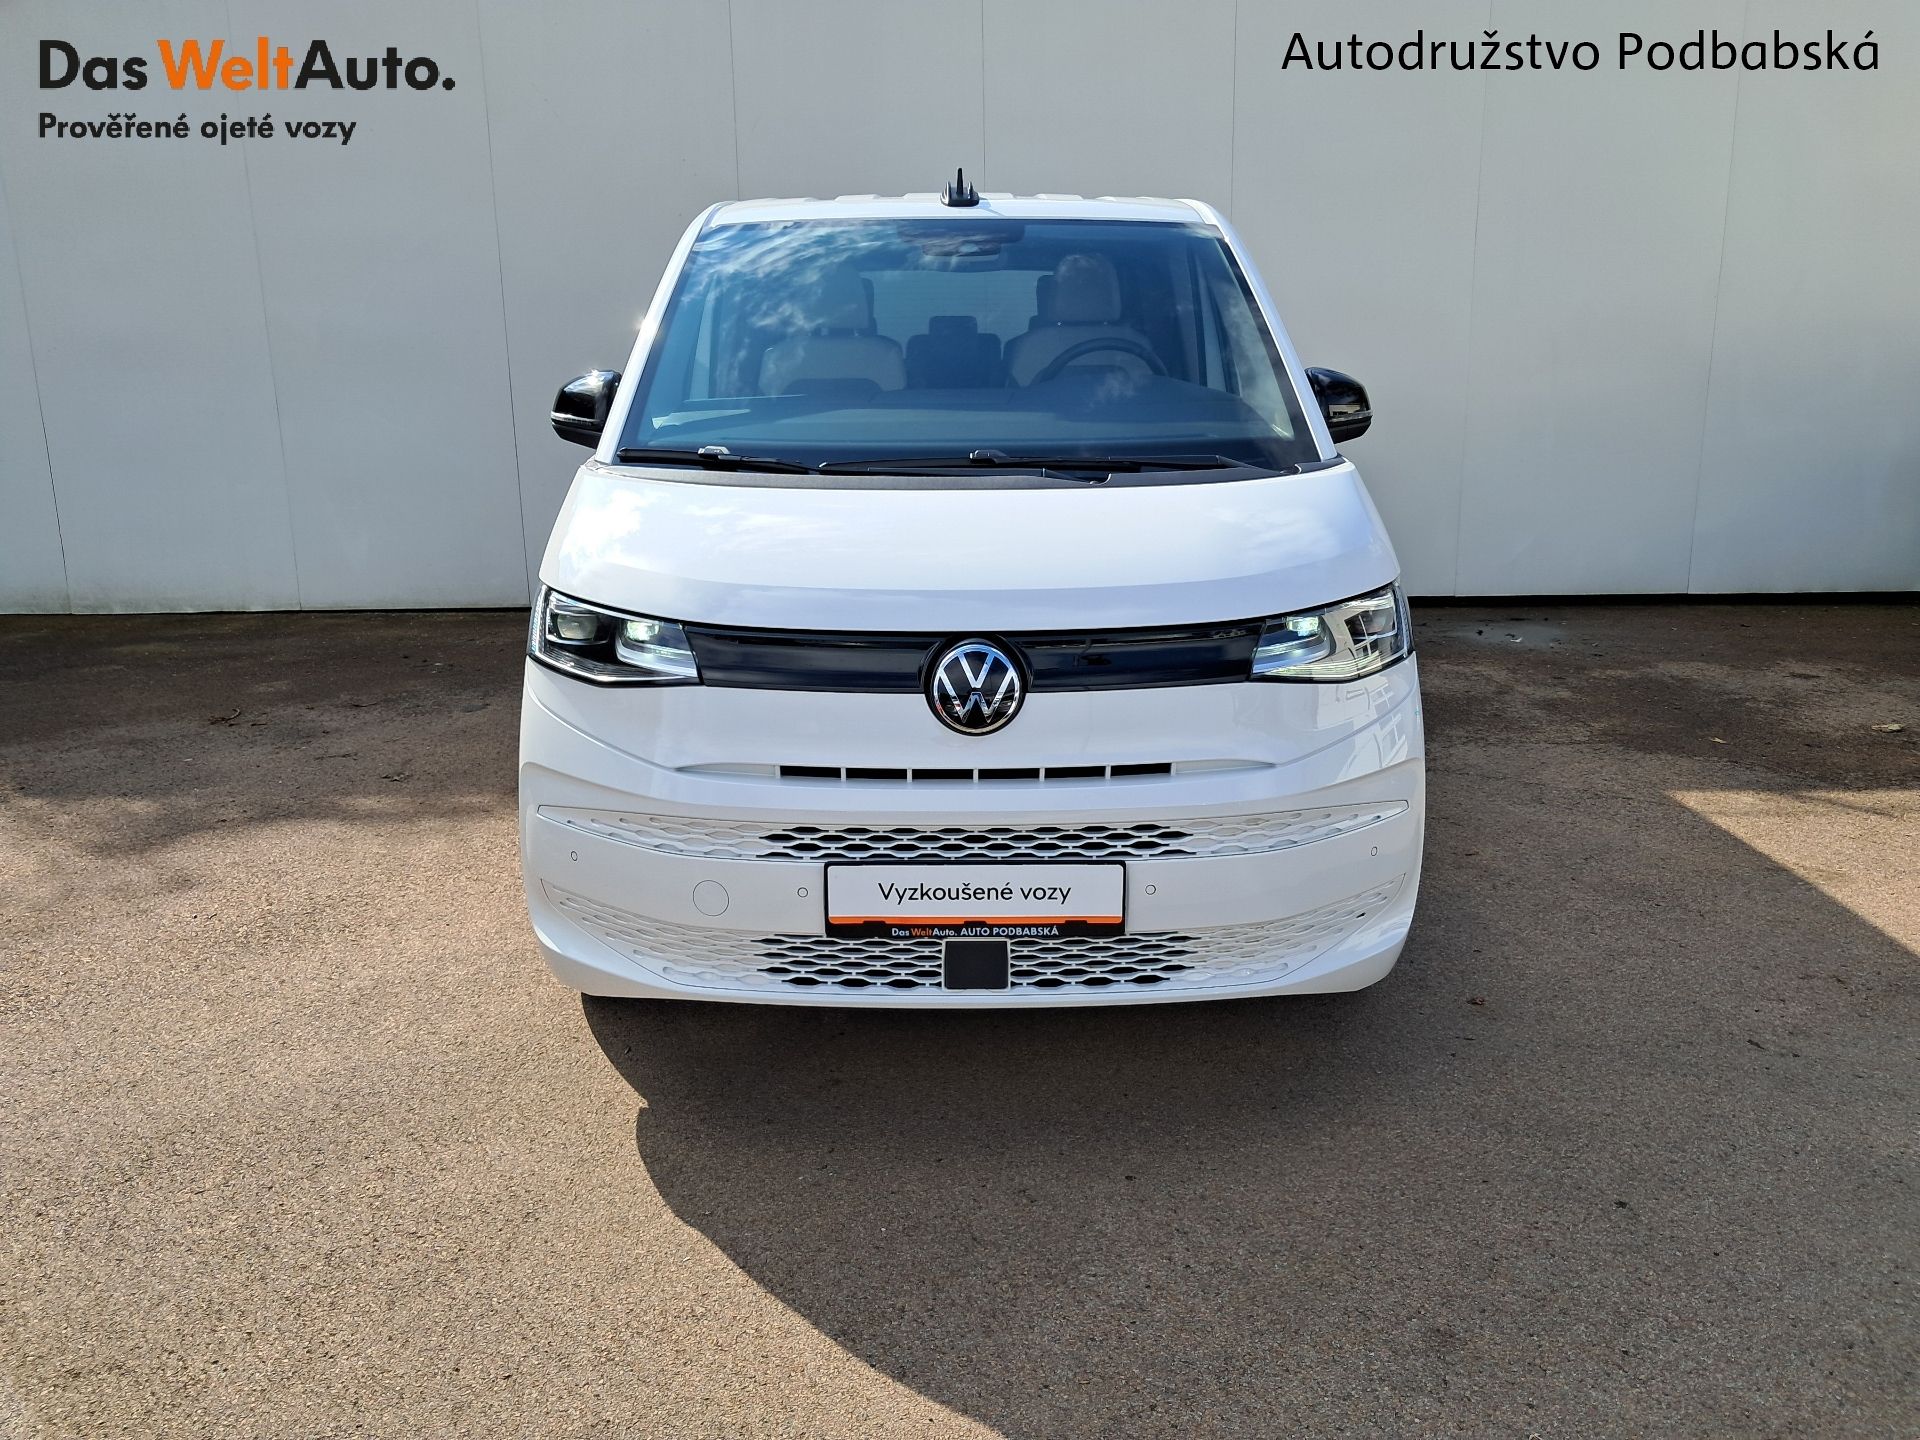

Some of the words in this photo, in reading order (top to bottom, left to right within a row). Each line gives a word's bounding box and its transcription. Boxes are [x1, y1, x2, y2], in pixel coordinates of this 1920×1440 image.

[877, 881, 1014, 906] Vyzkoušené
[1019, 887, 1072, 905] vozy
[891, 927, 910, 937] Das
[960, 927, 990, 937] AUTO
[992, 925, 1059, 937] PODBABSKÁ
